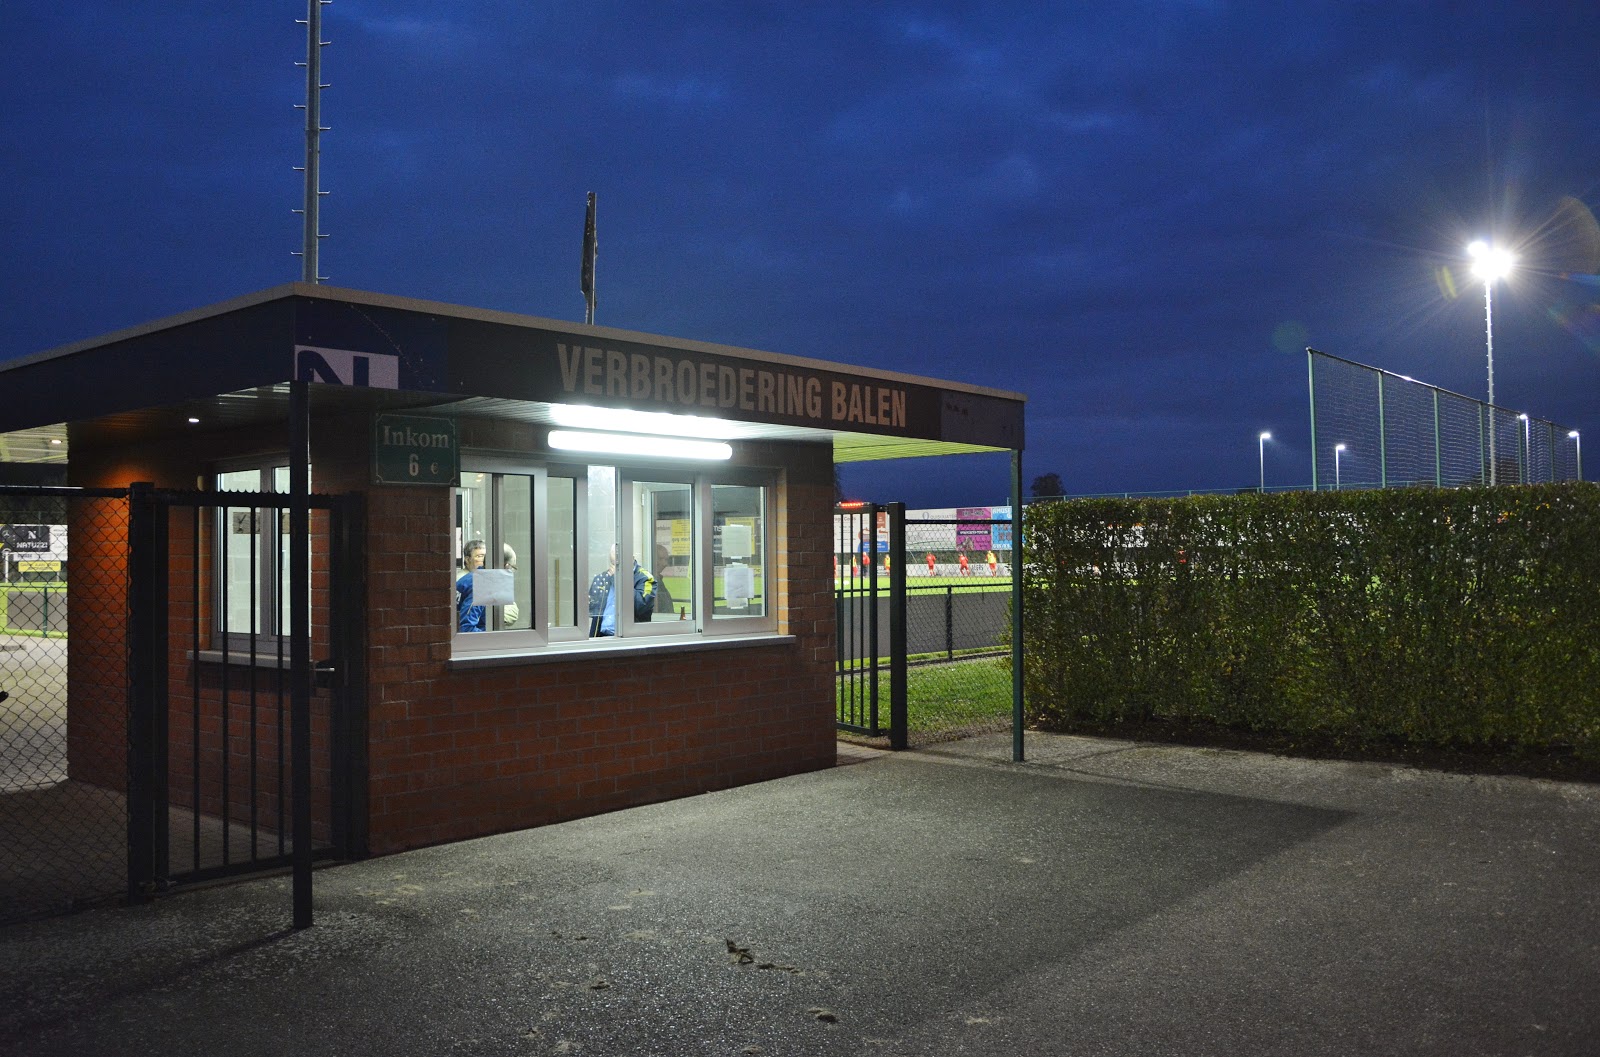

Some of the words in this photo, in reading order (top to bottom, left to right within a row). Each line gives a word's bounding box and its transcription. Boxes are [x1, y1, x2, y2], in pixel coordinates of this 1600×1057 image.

[557, 343, 822, 419] VERBROEDERING
[831, 381, 906, 428] BALEN
[383, 425, 449, 449] Inkom
[409, 453, 419, 477] 6
